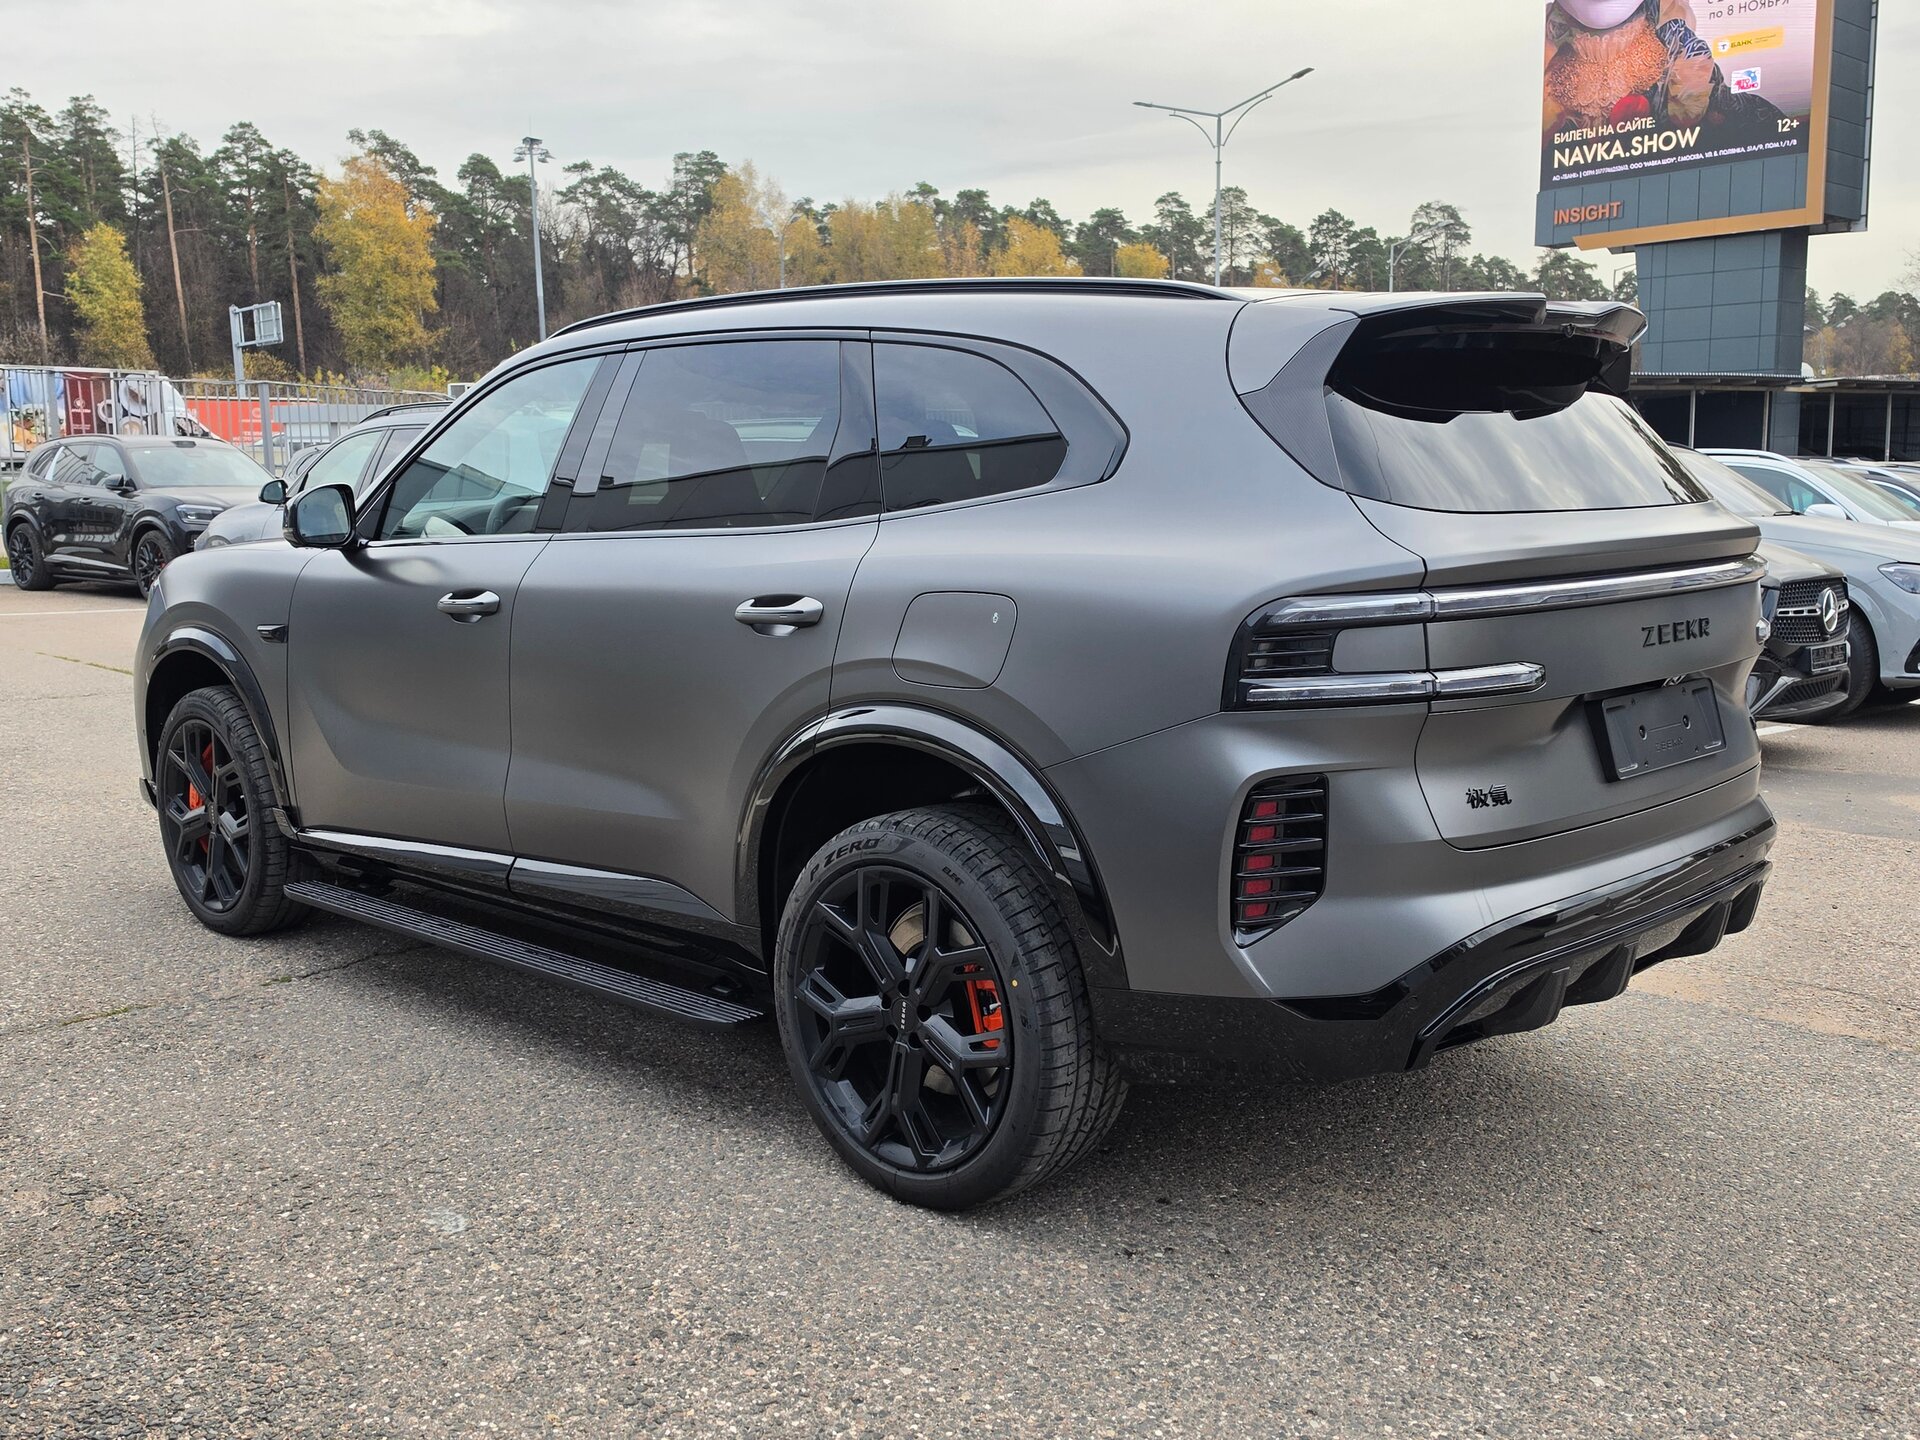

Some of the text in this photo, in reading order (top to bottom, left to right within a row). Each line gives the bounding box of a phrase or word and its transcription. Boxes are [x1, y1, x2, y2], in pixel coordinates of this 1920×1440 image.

[1709, 11, 1723, 19] по
[1727, 5, 1734, 16] 8
[1554, 117, 1656, 144] БИЛЕТЫ НА САЙТЕ:
[1777, 118, 1800, 133] 12+
[1553, 126, 1701, 169] NAVKA.SHOW
[1553, 201, 1622, 225] INSIGHT
[1641, 617, 1710, 648] ZEEKR
[1465, 784, 1513, 809] 极氪
[823, 836, 883, 868] ZERO
